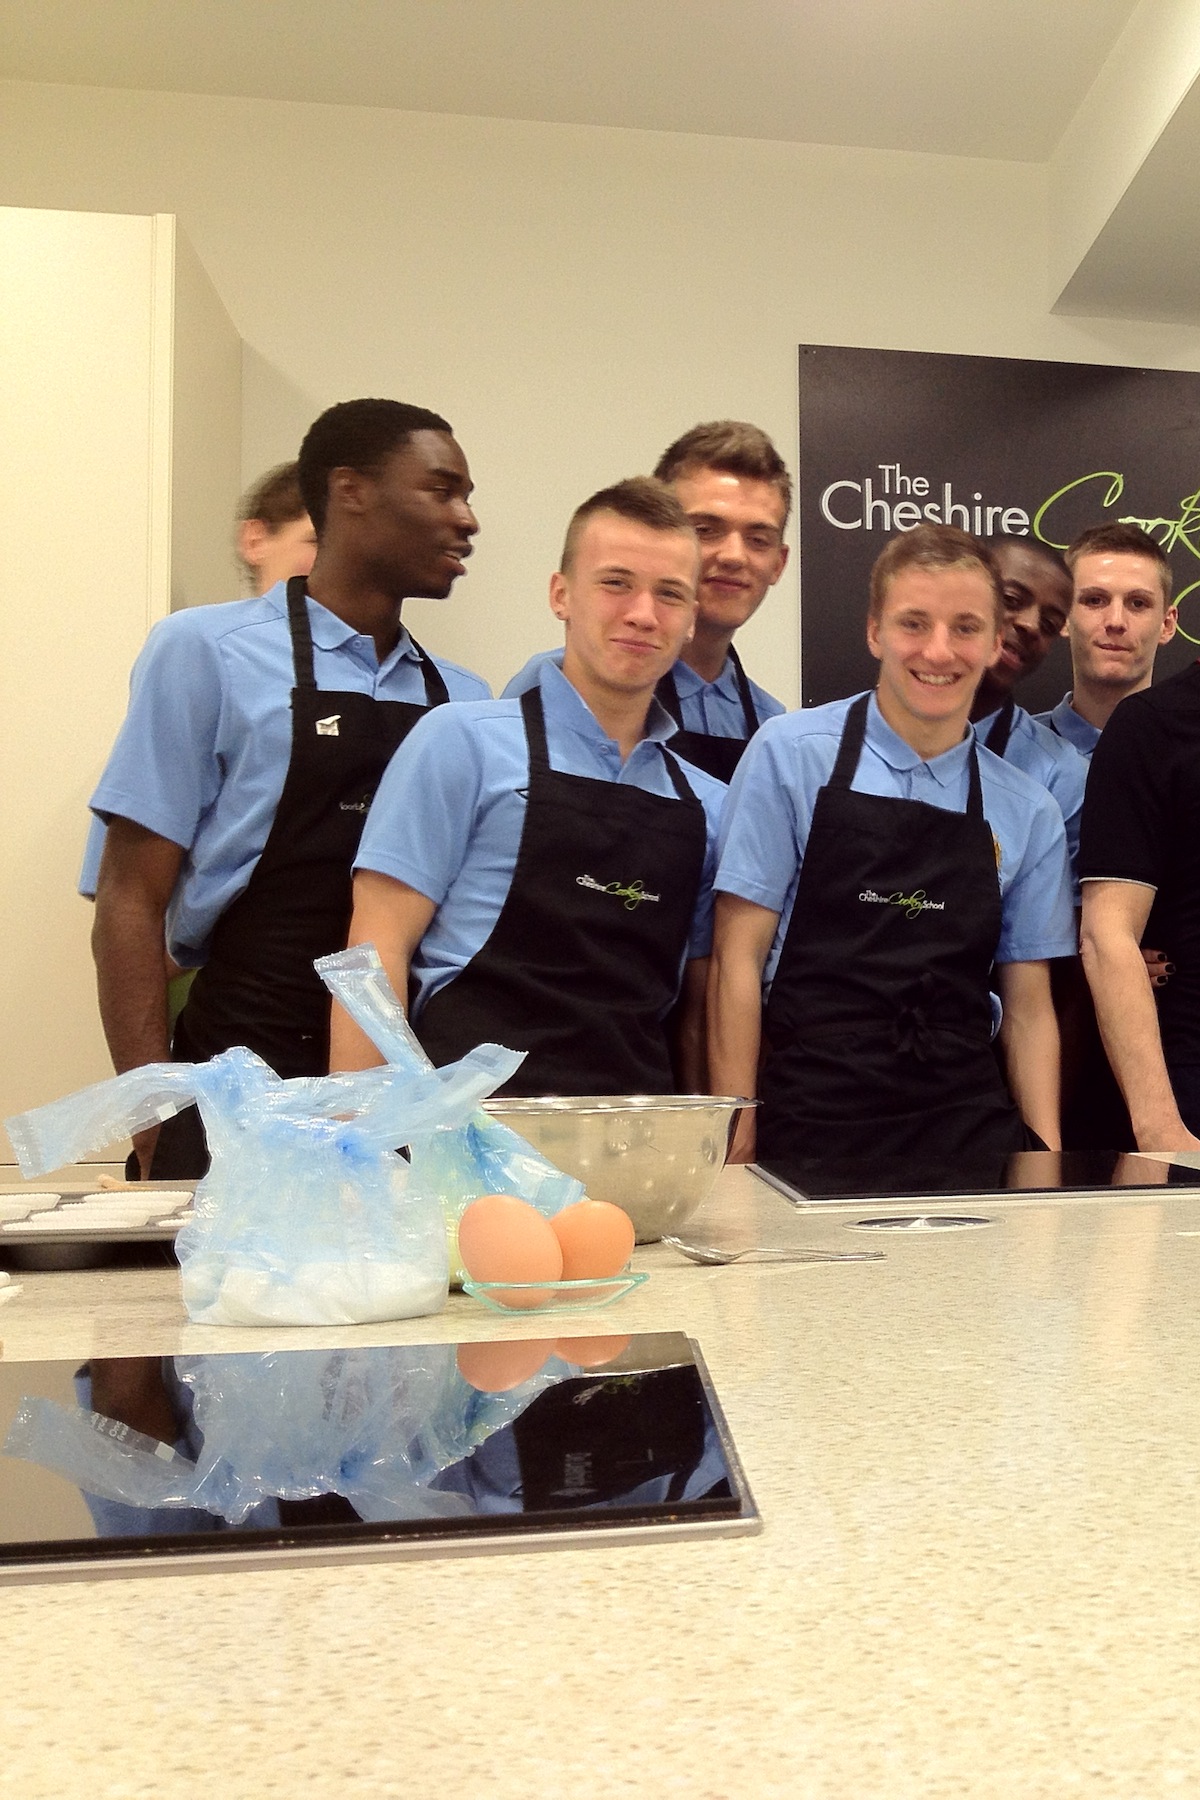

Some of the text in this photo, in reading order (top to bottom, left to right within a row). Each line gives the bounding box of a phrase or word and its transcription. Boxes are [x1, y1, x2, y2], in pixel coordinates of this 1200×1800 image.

[878, 462, 930, 496] The
[821, 478, 1030, 537] Cheshire
[922, 900, 945, 910] School
